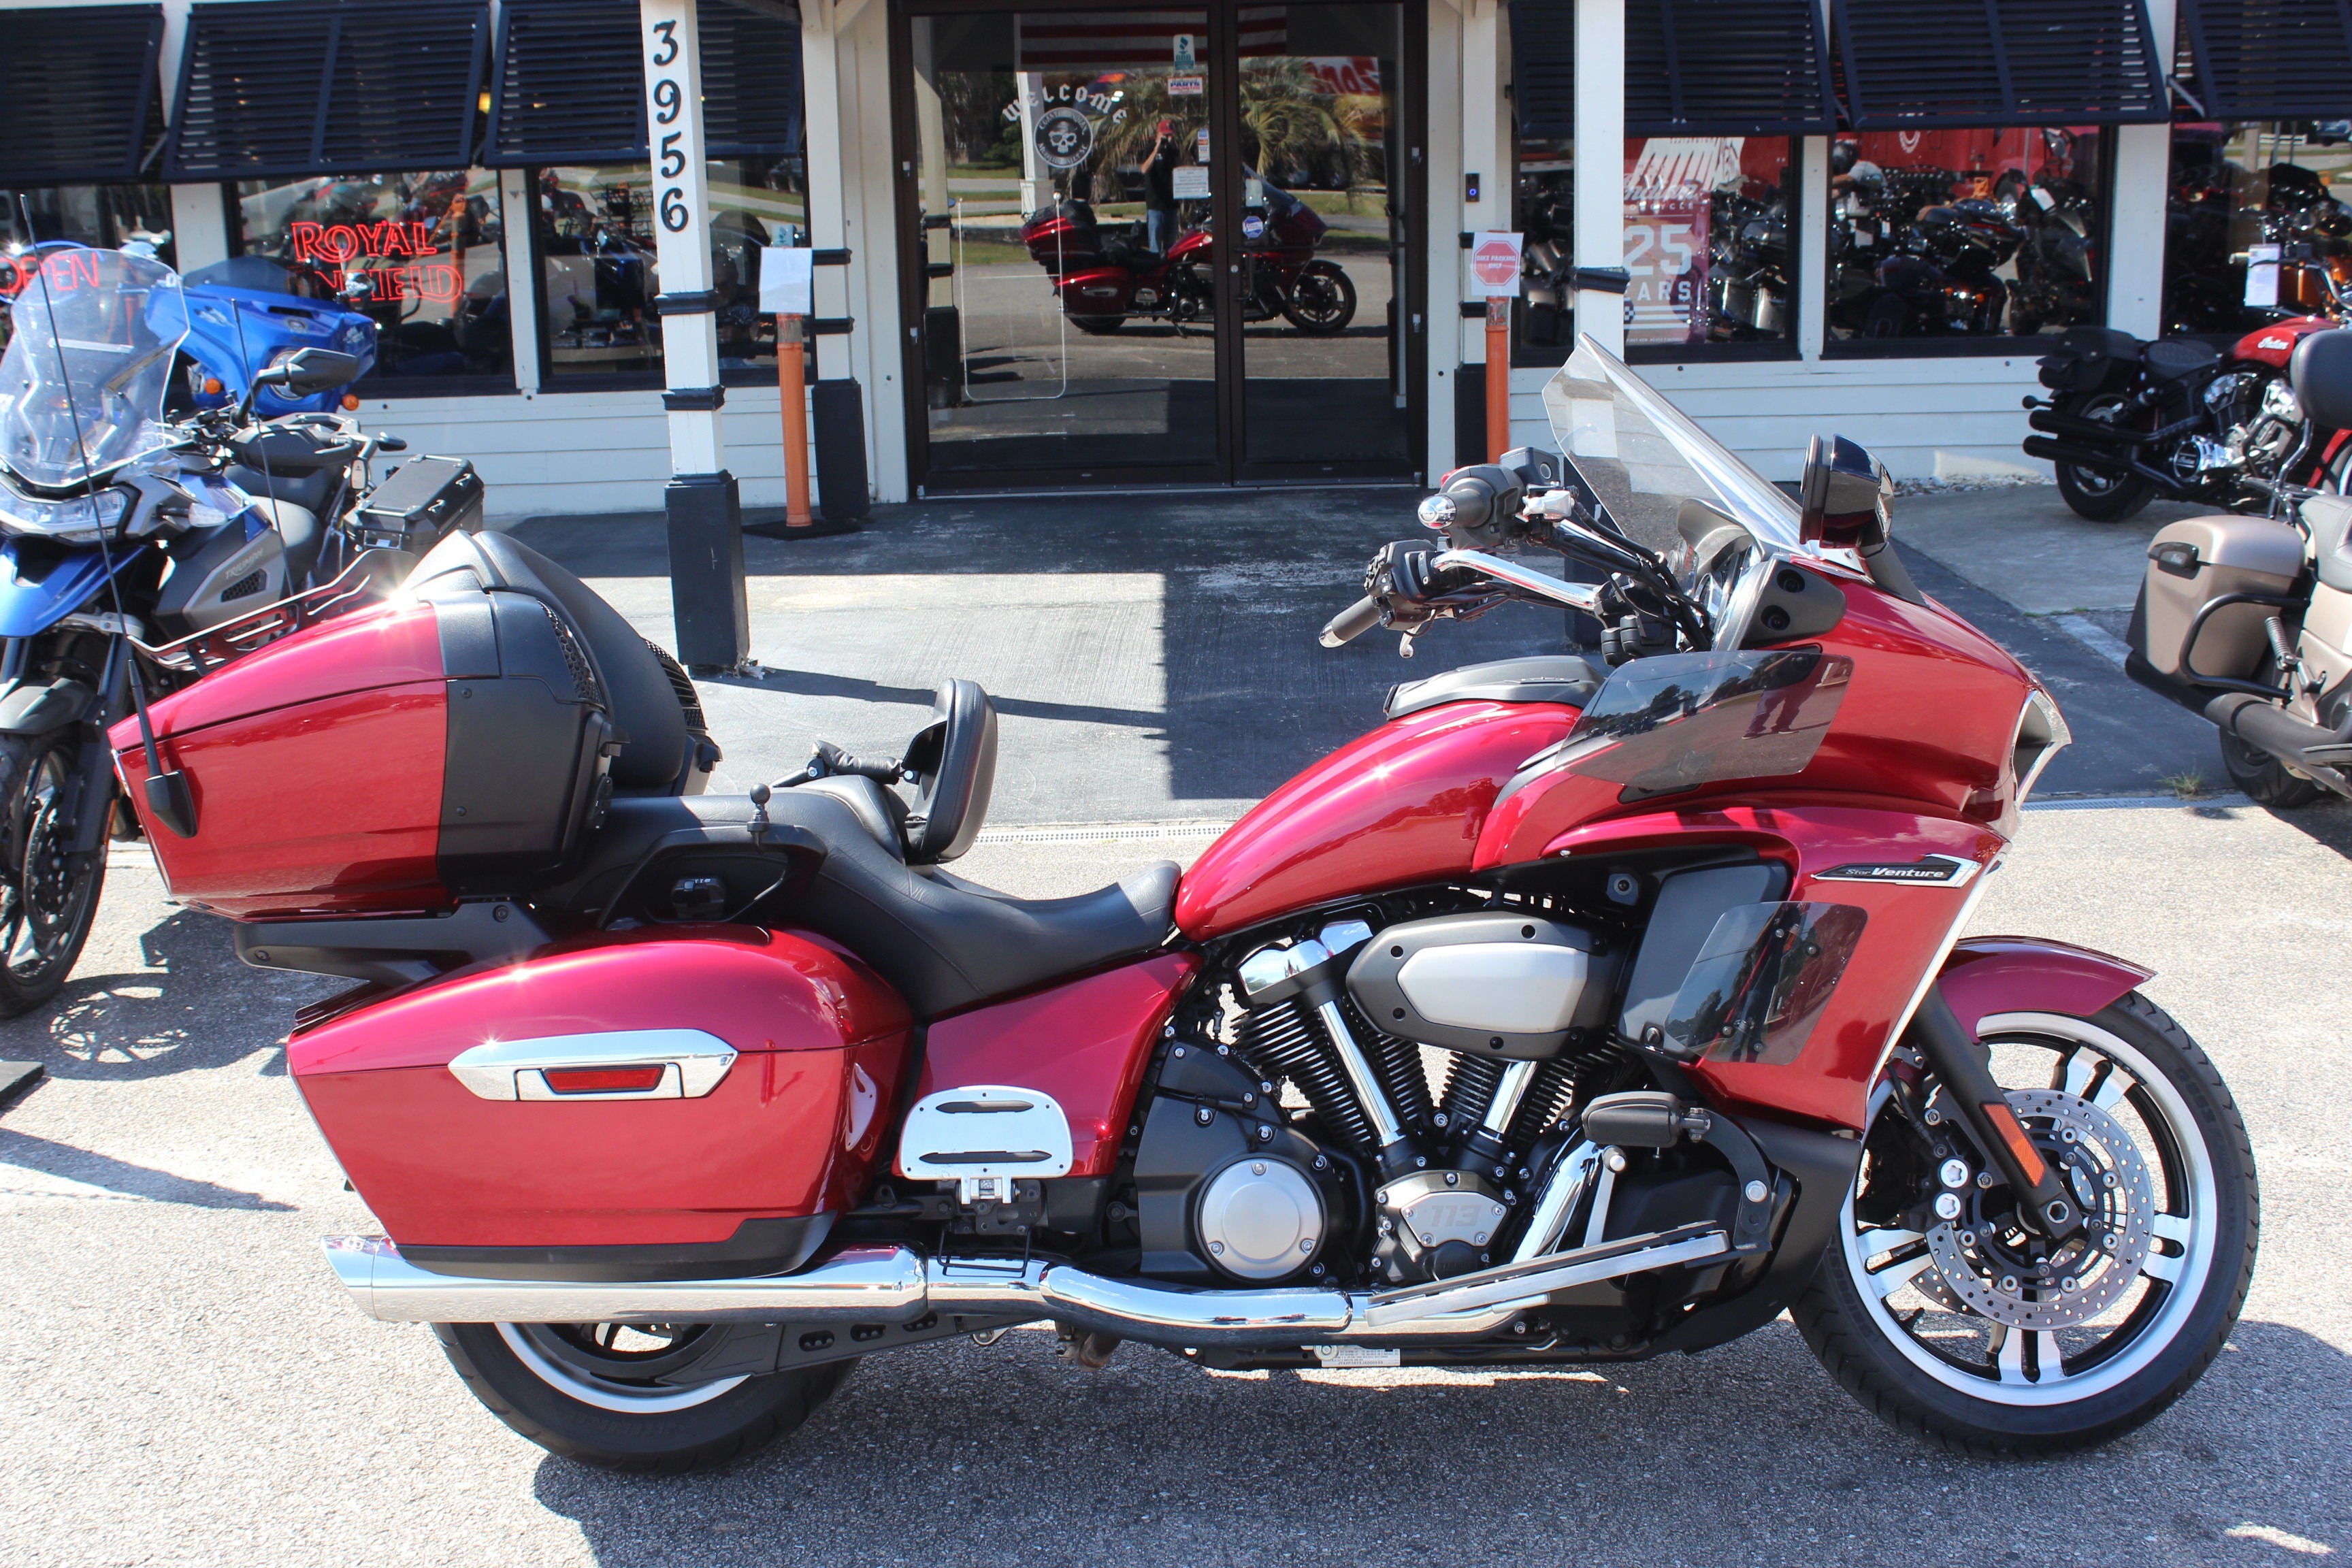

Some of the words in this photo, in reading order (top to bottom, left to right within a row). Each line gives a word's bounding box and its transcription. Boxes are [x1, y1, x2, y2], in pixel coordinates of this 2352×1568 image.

[653, 19, 689, 233] 3956
[291, 222, 438, 263] ROYAL
[1623, 224, 1693, 275] 25
[225, 547, 264, 580] TRIUMPH
[1871, 867, 1945, 878] Venture
[1431, 1204, 1482, 1228] 113
